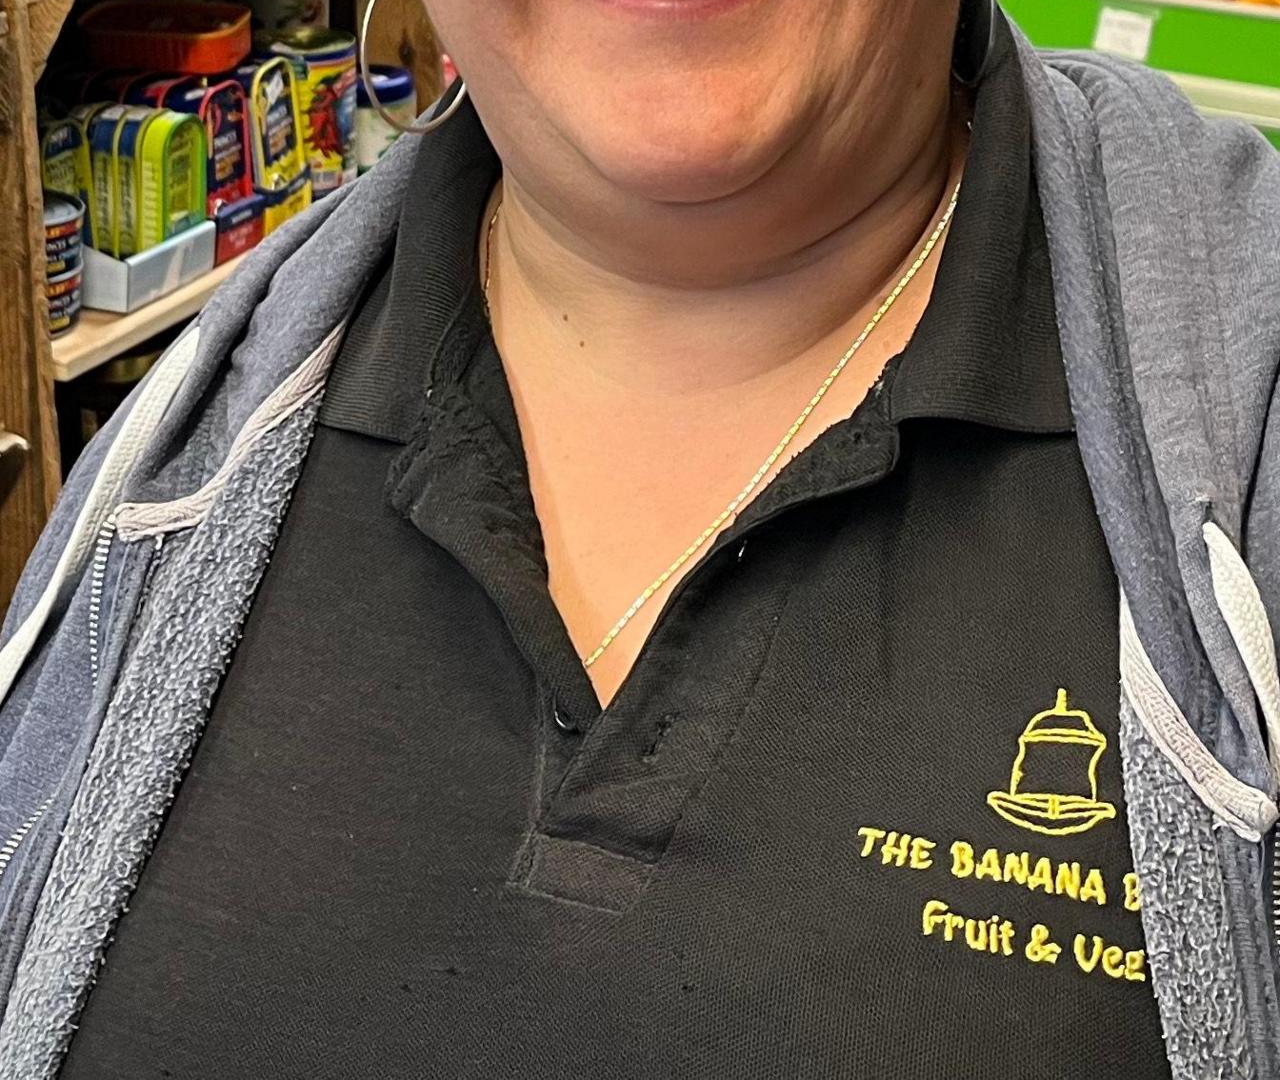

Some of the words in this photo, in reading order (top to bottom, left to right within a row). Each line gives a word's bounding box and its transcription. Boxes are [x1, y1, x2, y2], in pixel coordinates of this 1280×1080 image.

[857, 826, 937, 870] THE
[949, 840, 1107, 906] BANANA
[922, 900, 1016, 956] Fruit
[1025, 923, 1062, 964] &
